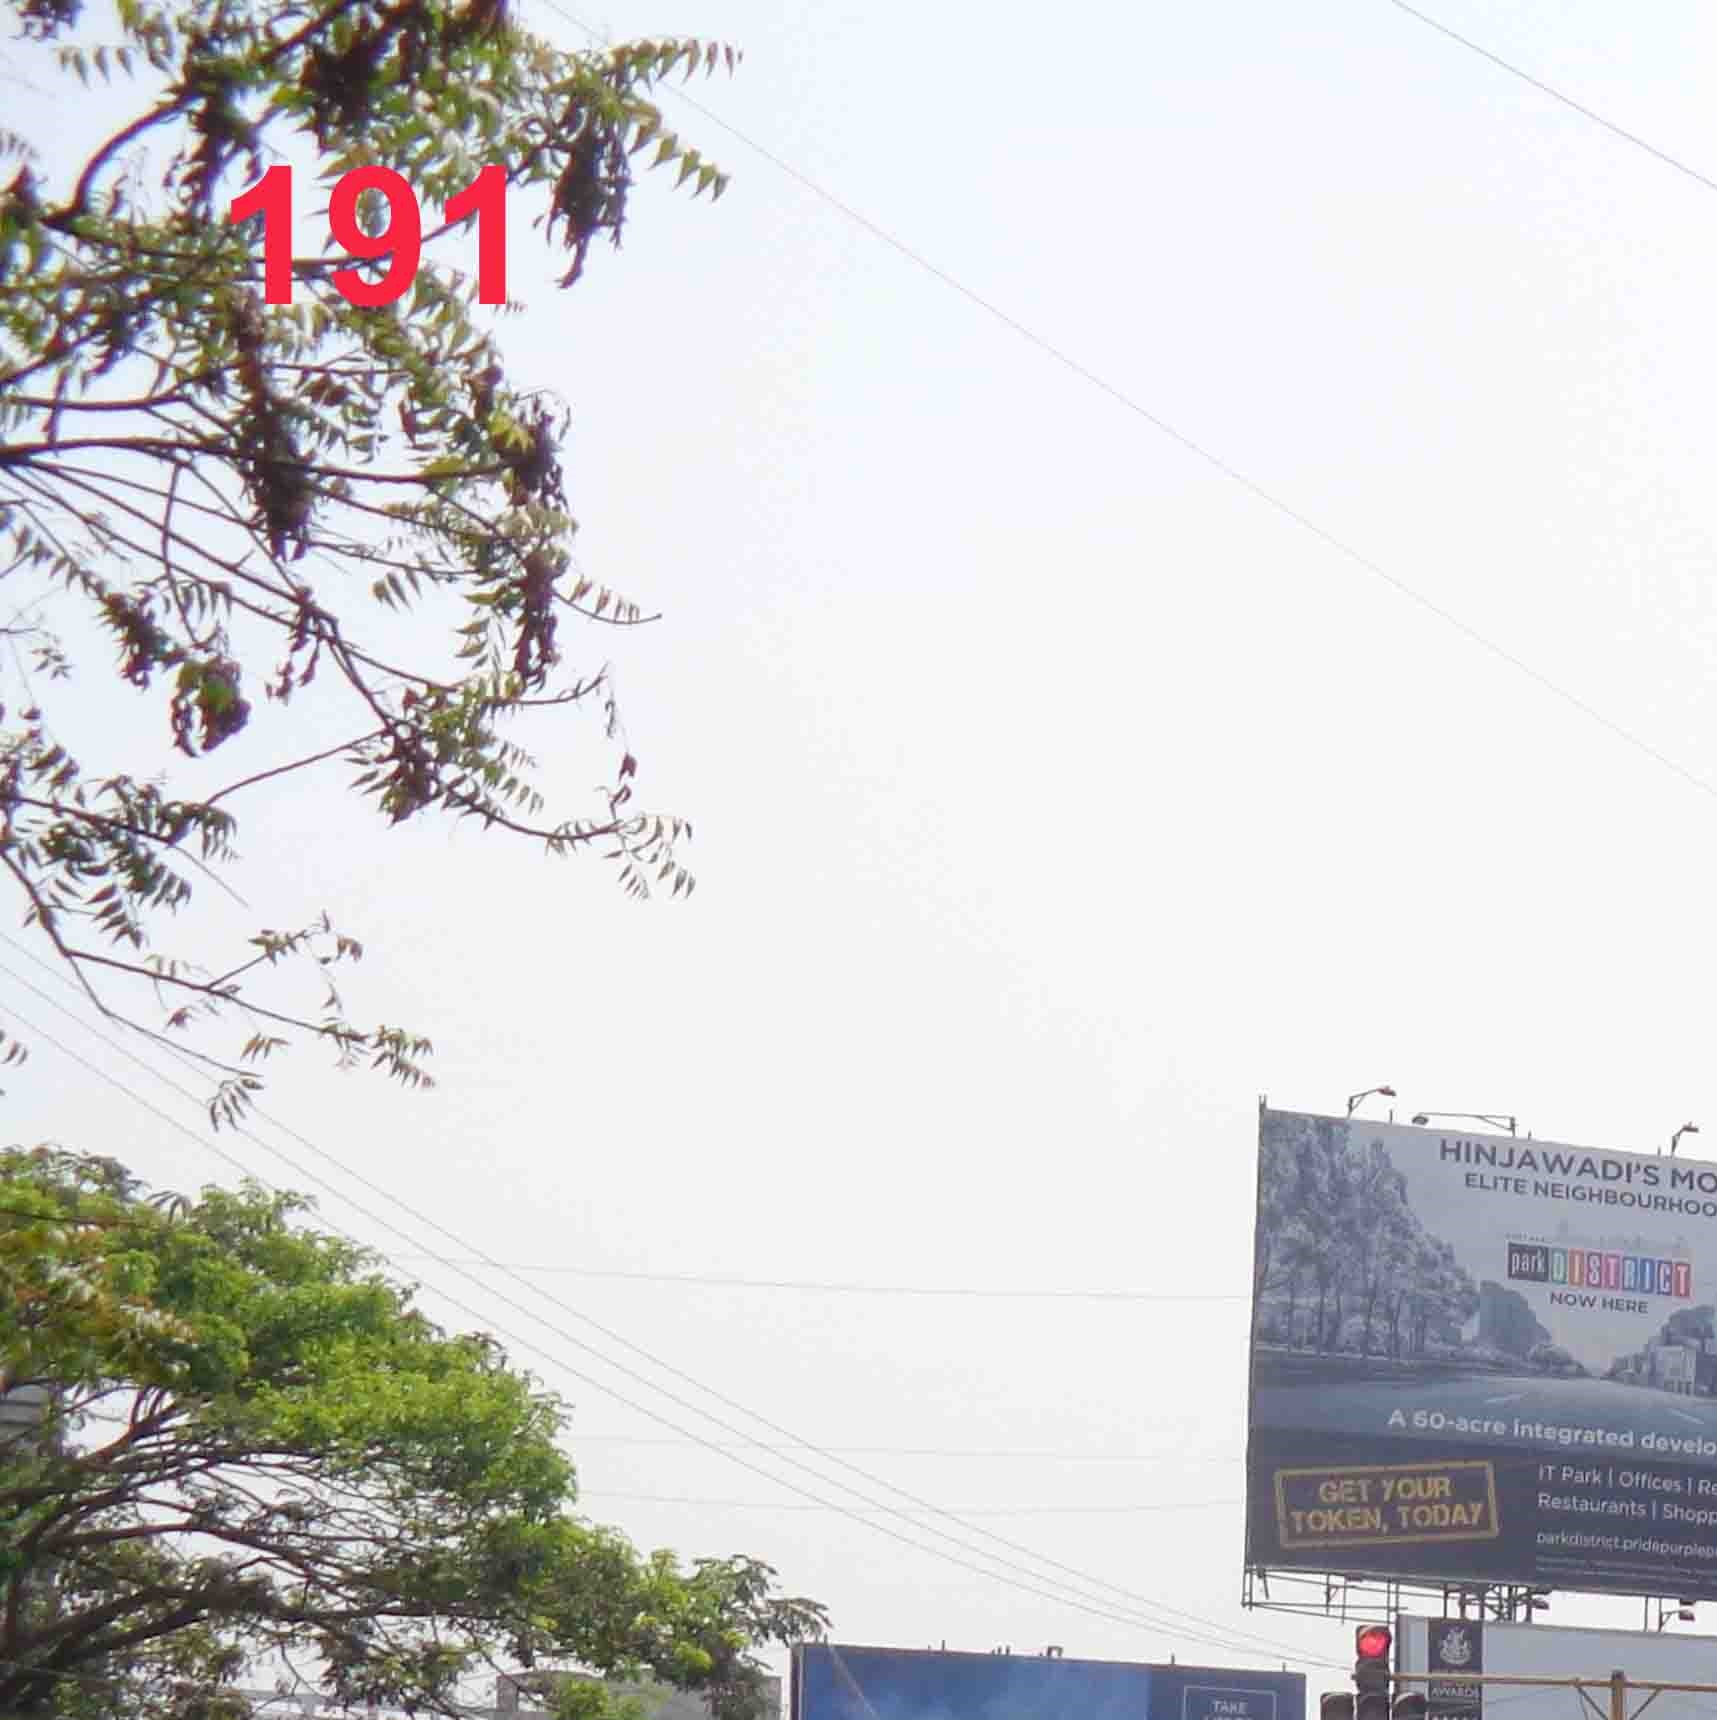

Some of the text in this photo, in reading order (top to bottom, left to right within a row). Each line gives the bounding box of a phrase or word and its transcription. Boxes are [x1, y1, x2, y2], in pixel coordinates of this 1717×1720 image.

[1440, 1138, 1660, 1187] HINJAWADI'S
[1465, 1172, 1526, 1194] ELITE
[1510, 1247, 1690, 1297] park DISTRICT
[1550, 1292, 1648, 1313] NOW HERE
[1388, 1409, 1406, 1427] A
[1513, 1418, 1633, 1449] integrated
[1320, 1477, 1451, 1502] GET YOUR
[1562, 1466, 1601, 1484] Park
[1619, 1471, 1681, 1494] Offices
[1291, 1503, 1483, 1533] TOKEN, TODAY
[1538, 1493, 1646, 1517] Restaurants
